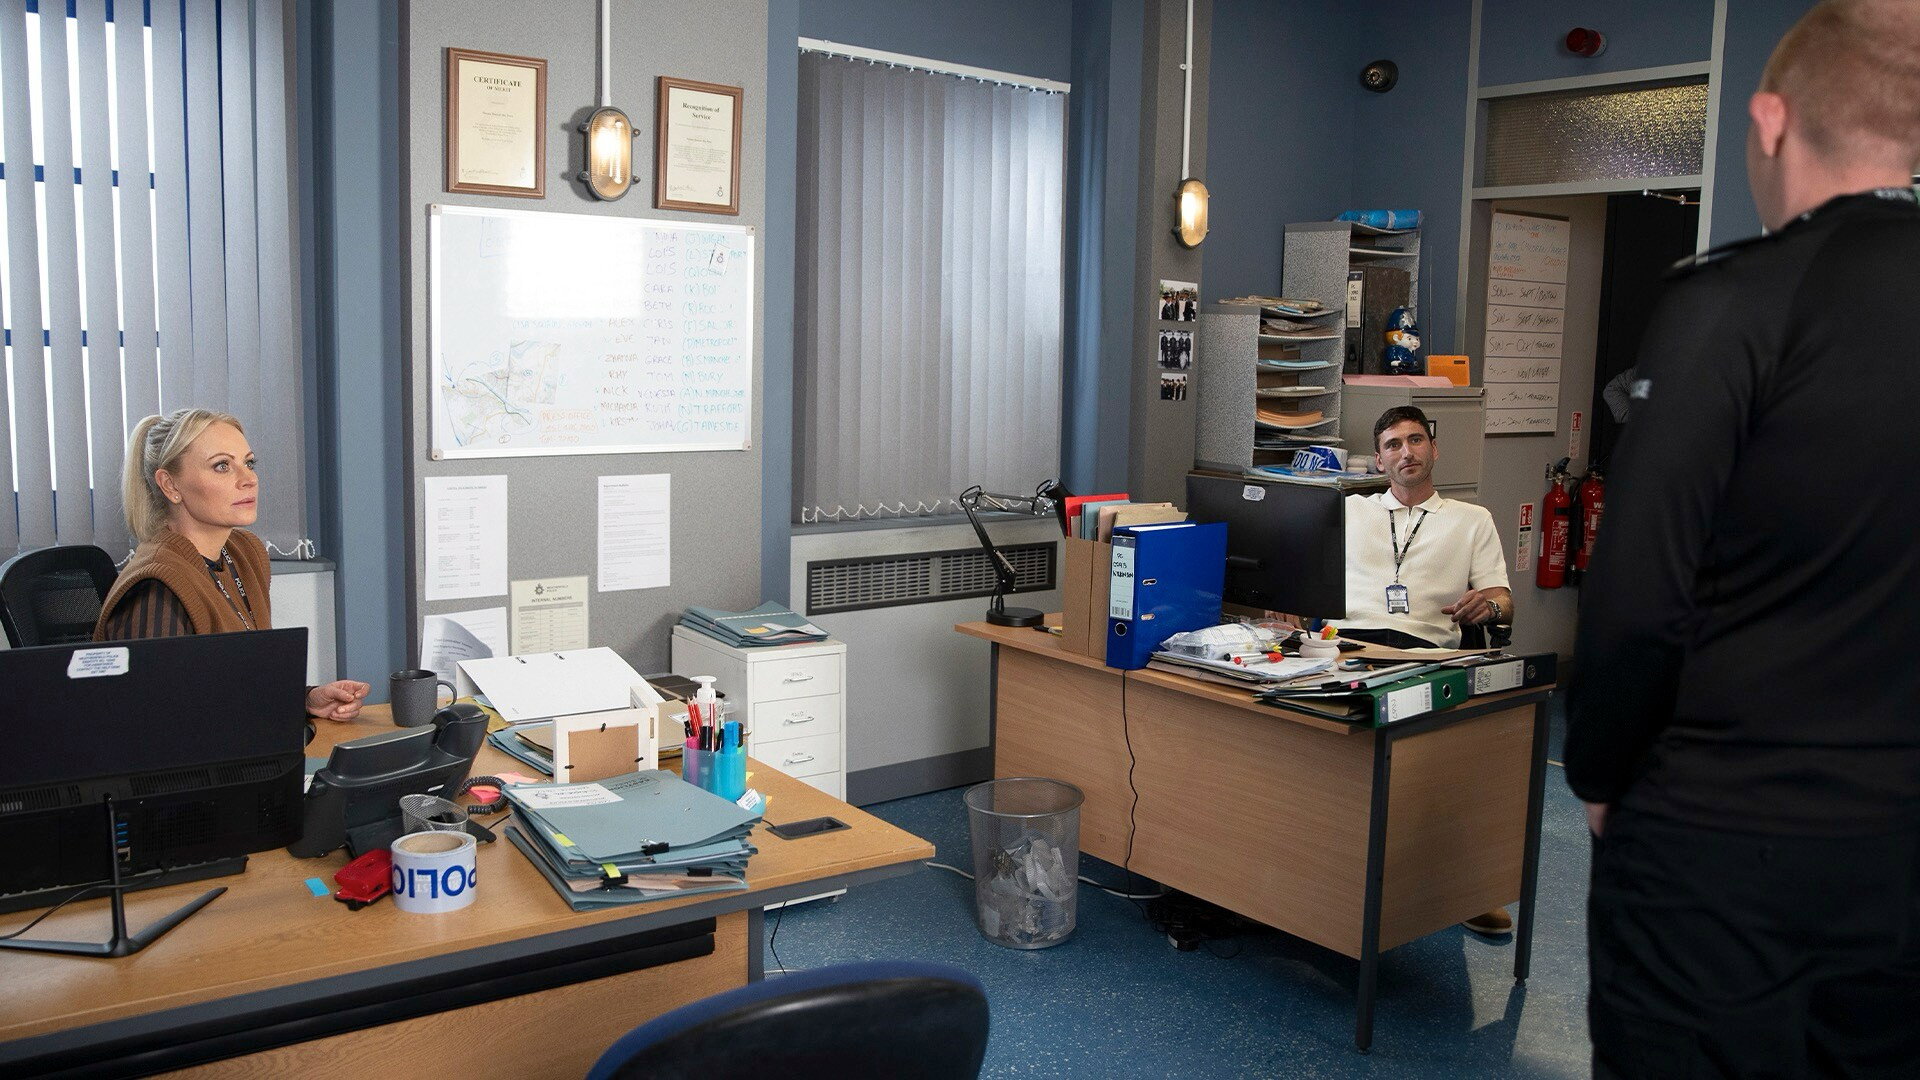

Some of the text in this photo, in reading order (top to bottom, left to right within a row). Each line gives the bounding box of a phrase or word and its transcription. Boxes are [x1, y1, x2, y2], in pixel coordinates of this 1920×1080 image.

[473, 76, 522, 88] CERTIFICATE
[682, 102, 713, 113] Recognition
[692, 112, 711, 120] Service
[603, 386, 629, 397] NICK
[1292, 452, 1309, 468] DO
[235, 578, 247, 596] POLICE
